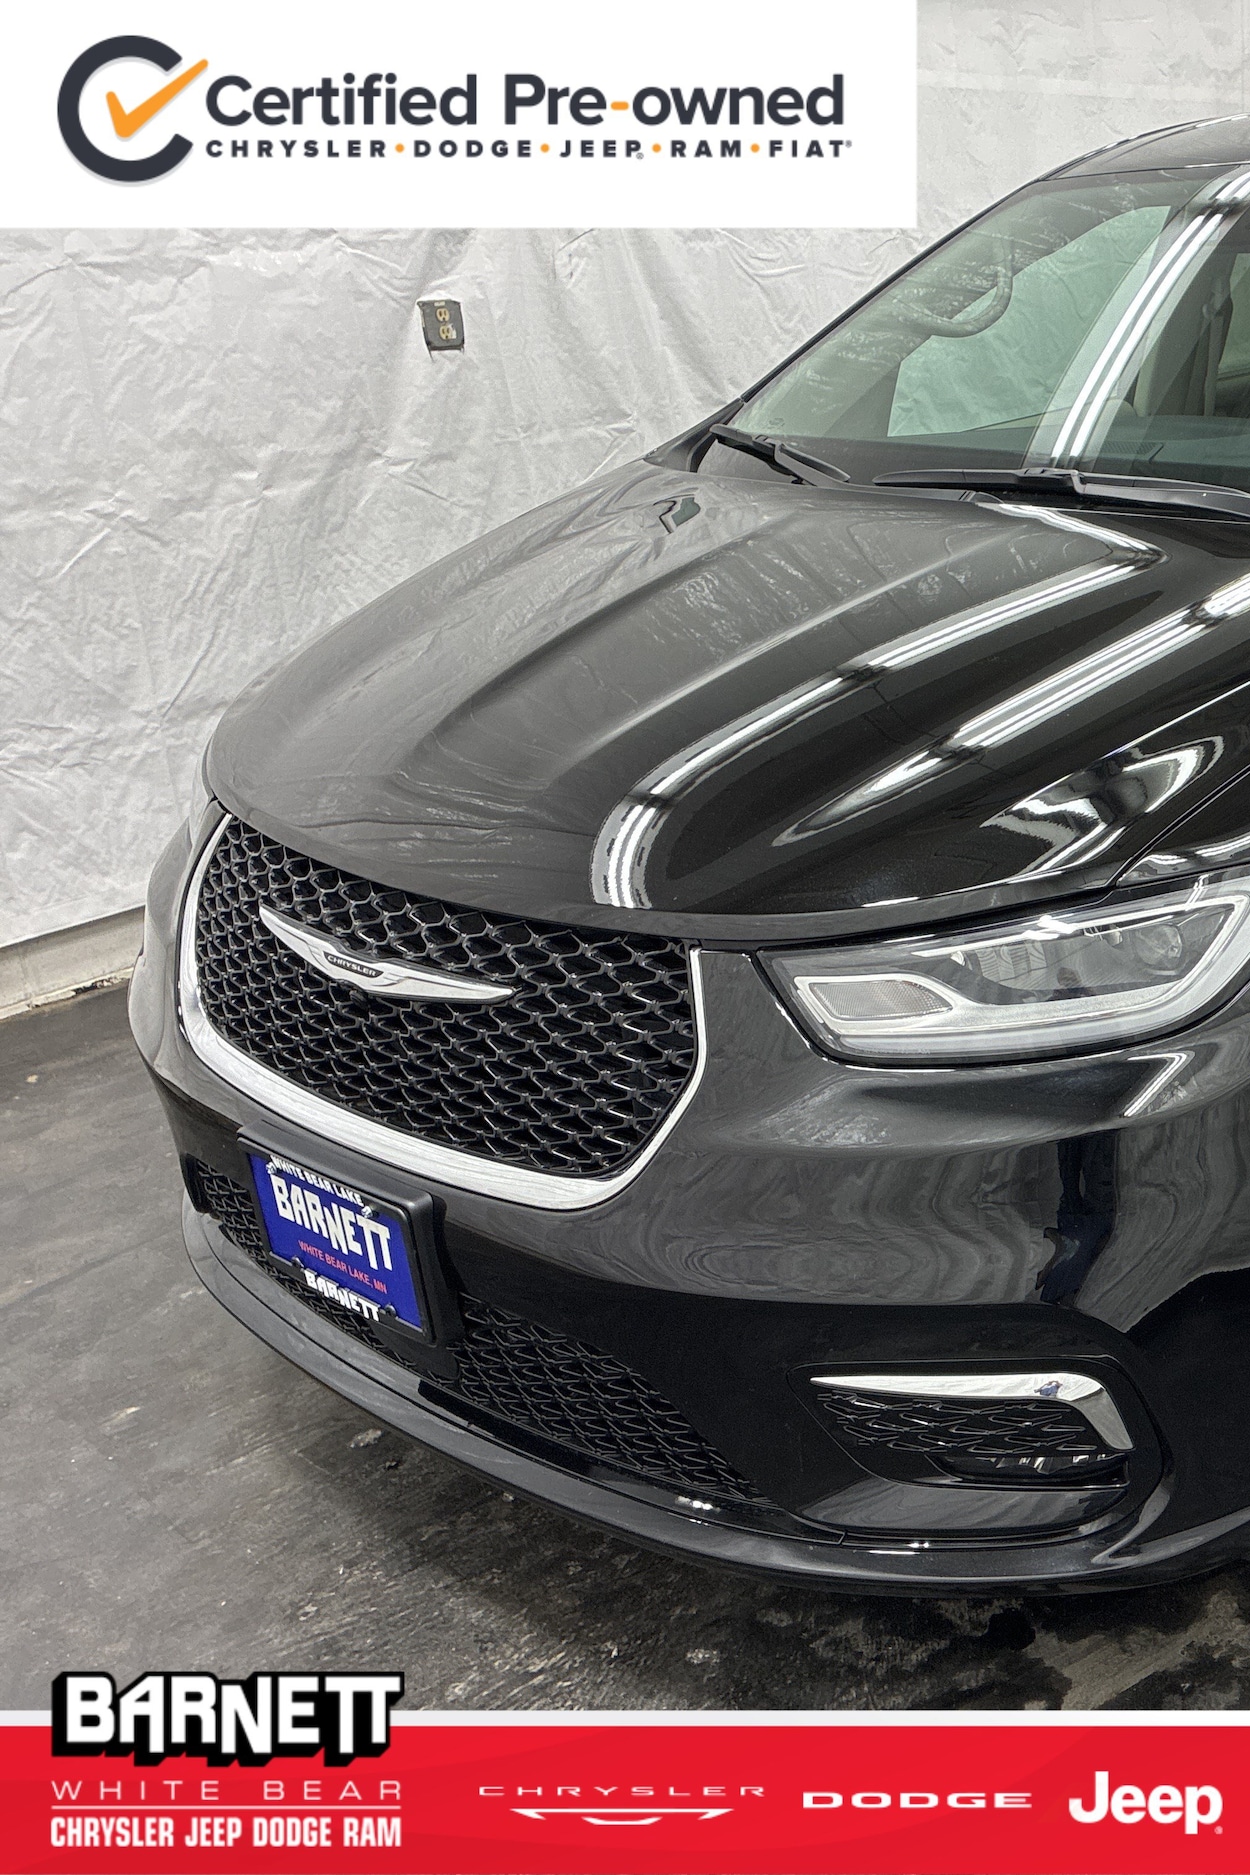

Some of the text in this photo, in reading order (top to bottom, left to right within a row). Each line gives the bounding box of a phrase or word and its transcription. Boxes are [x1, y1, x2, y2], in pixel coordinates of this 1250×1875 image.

[327, 955, 376, 976] CHRYSLER
[270, 1155, 365, 1208] WHITE BEAR LAKE
[270, 1174, 393, 1271] BARNETT
[299, 1240, 388, 1295] WHITE BEAR LAKE, MN
[304, 1270, 380, 1321] BARNETT
